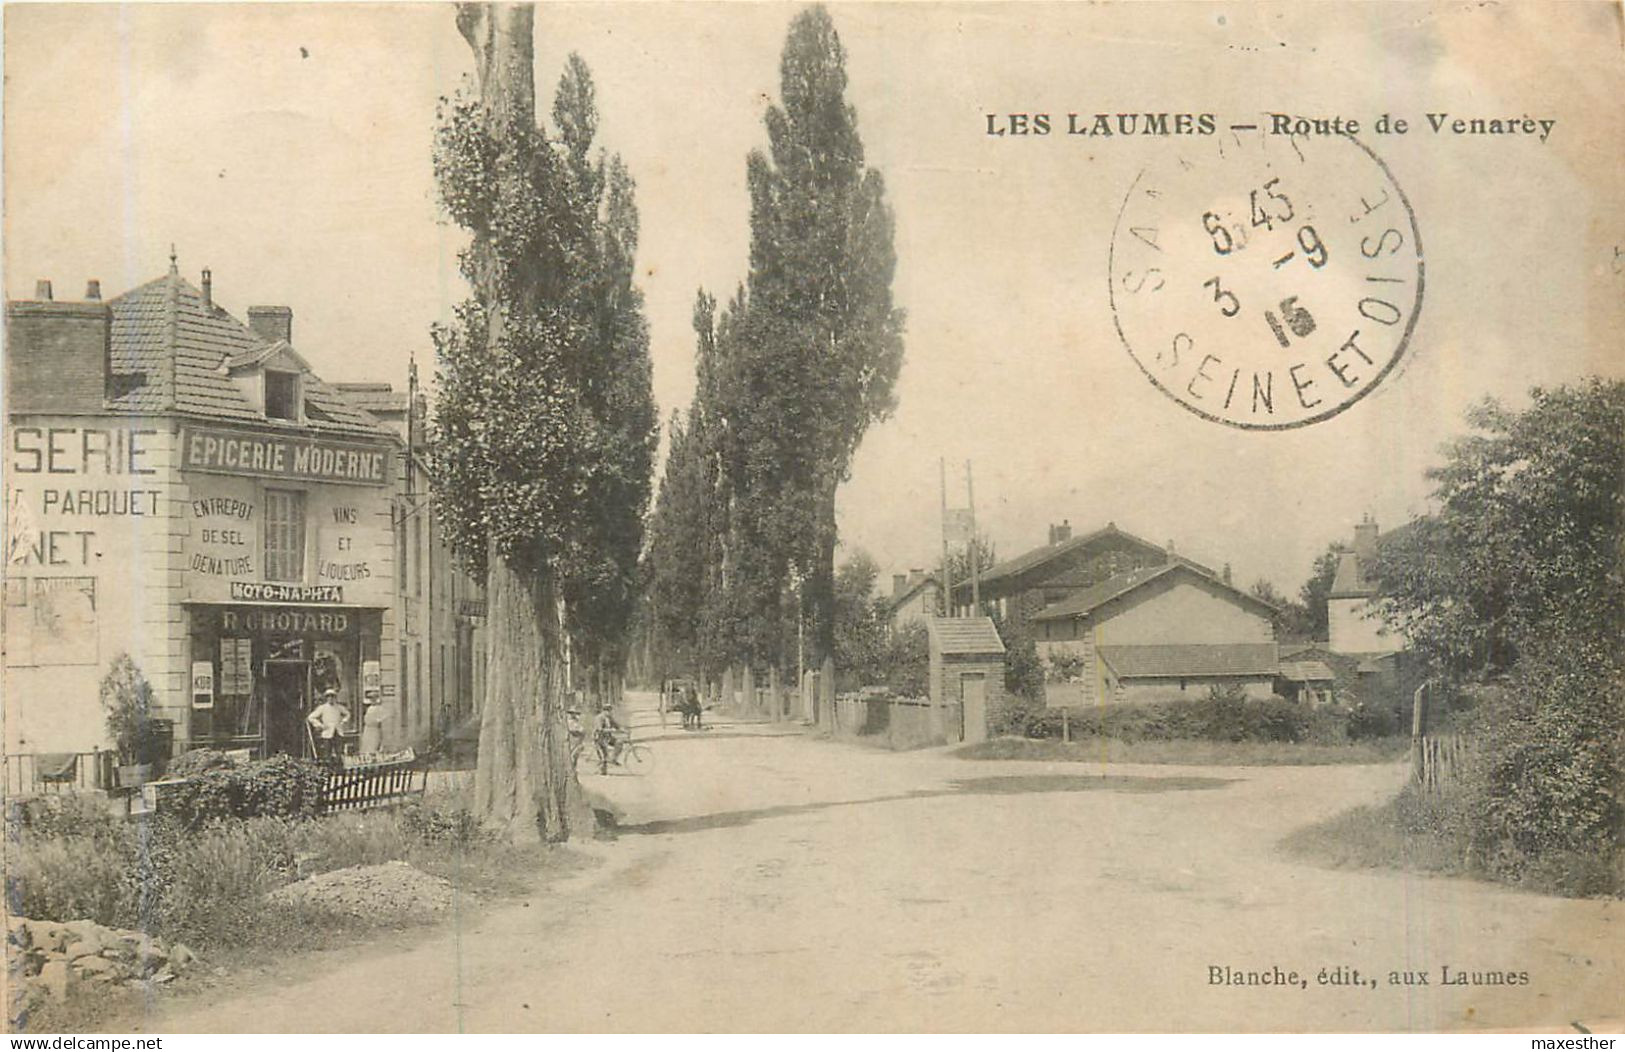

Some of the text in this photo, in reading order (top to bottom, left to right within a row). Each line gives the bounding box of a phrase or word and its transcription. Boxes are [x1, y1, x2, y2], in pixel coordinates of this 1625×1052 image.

[13, 427, 159, 475] SERIE
[293, 445, 384, 480] MODERNE
[43, 488, 163, 517] PARQUET
[192, 497, 254, 521] ENTREPOT
[332, 507, 357, 524] VINS
[202, 529, 245, 546] DE SEL
[338, 536, 352, 552] ET
[192, 553, 254, 576] DENATURE
[319, 559, 371, 581] LIQUEURS
[232, 583, 341, 602] MOTO-NAPHTA
